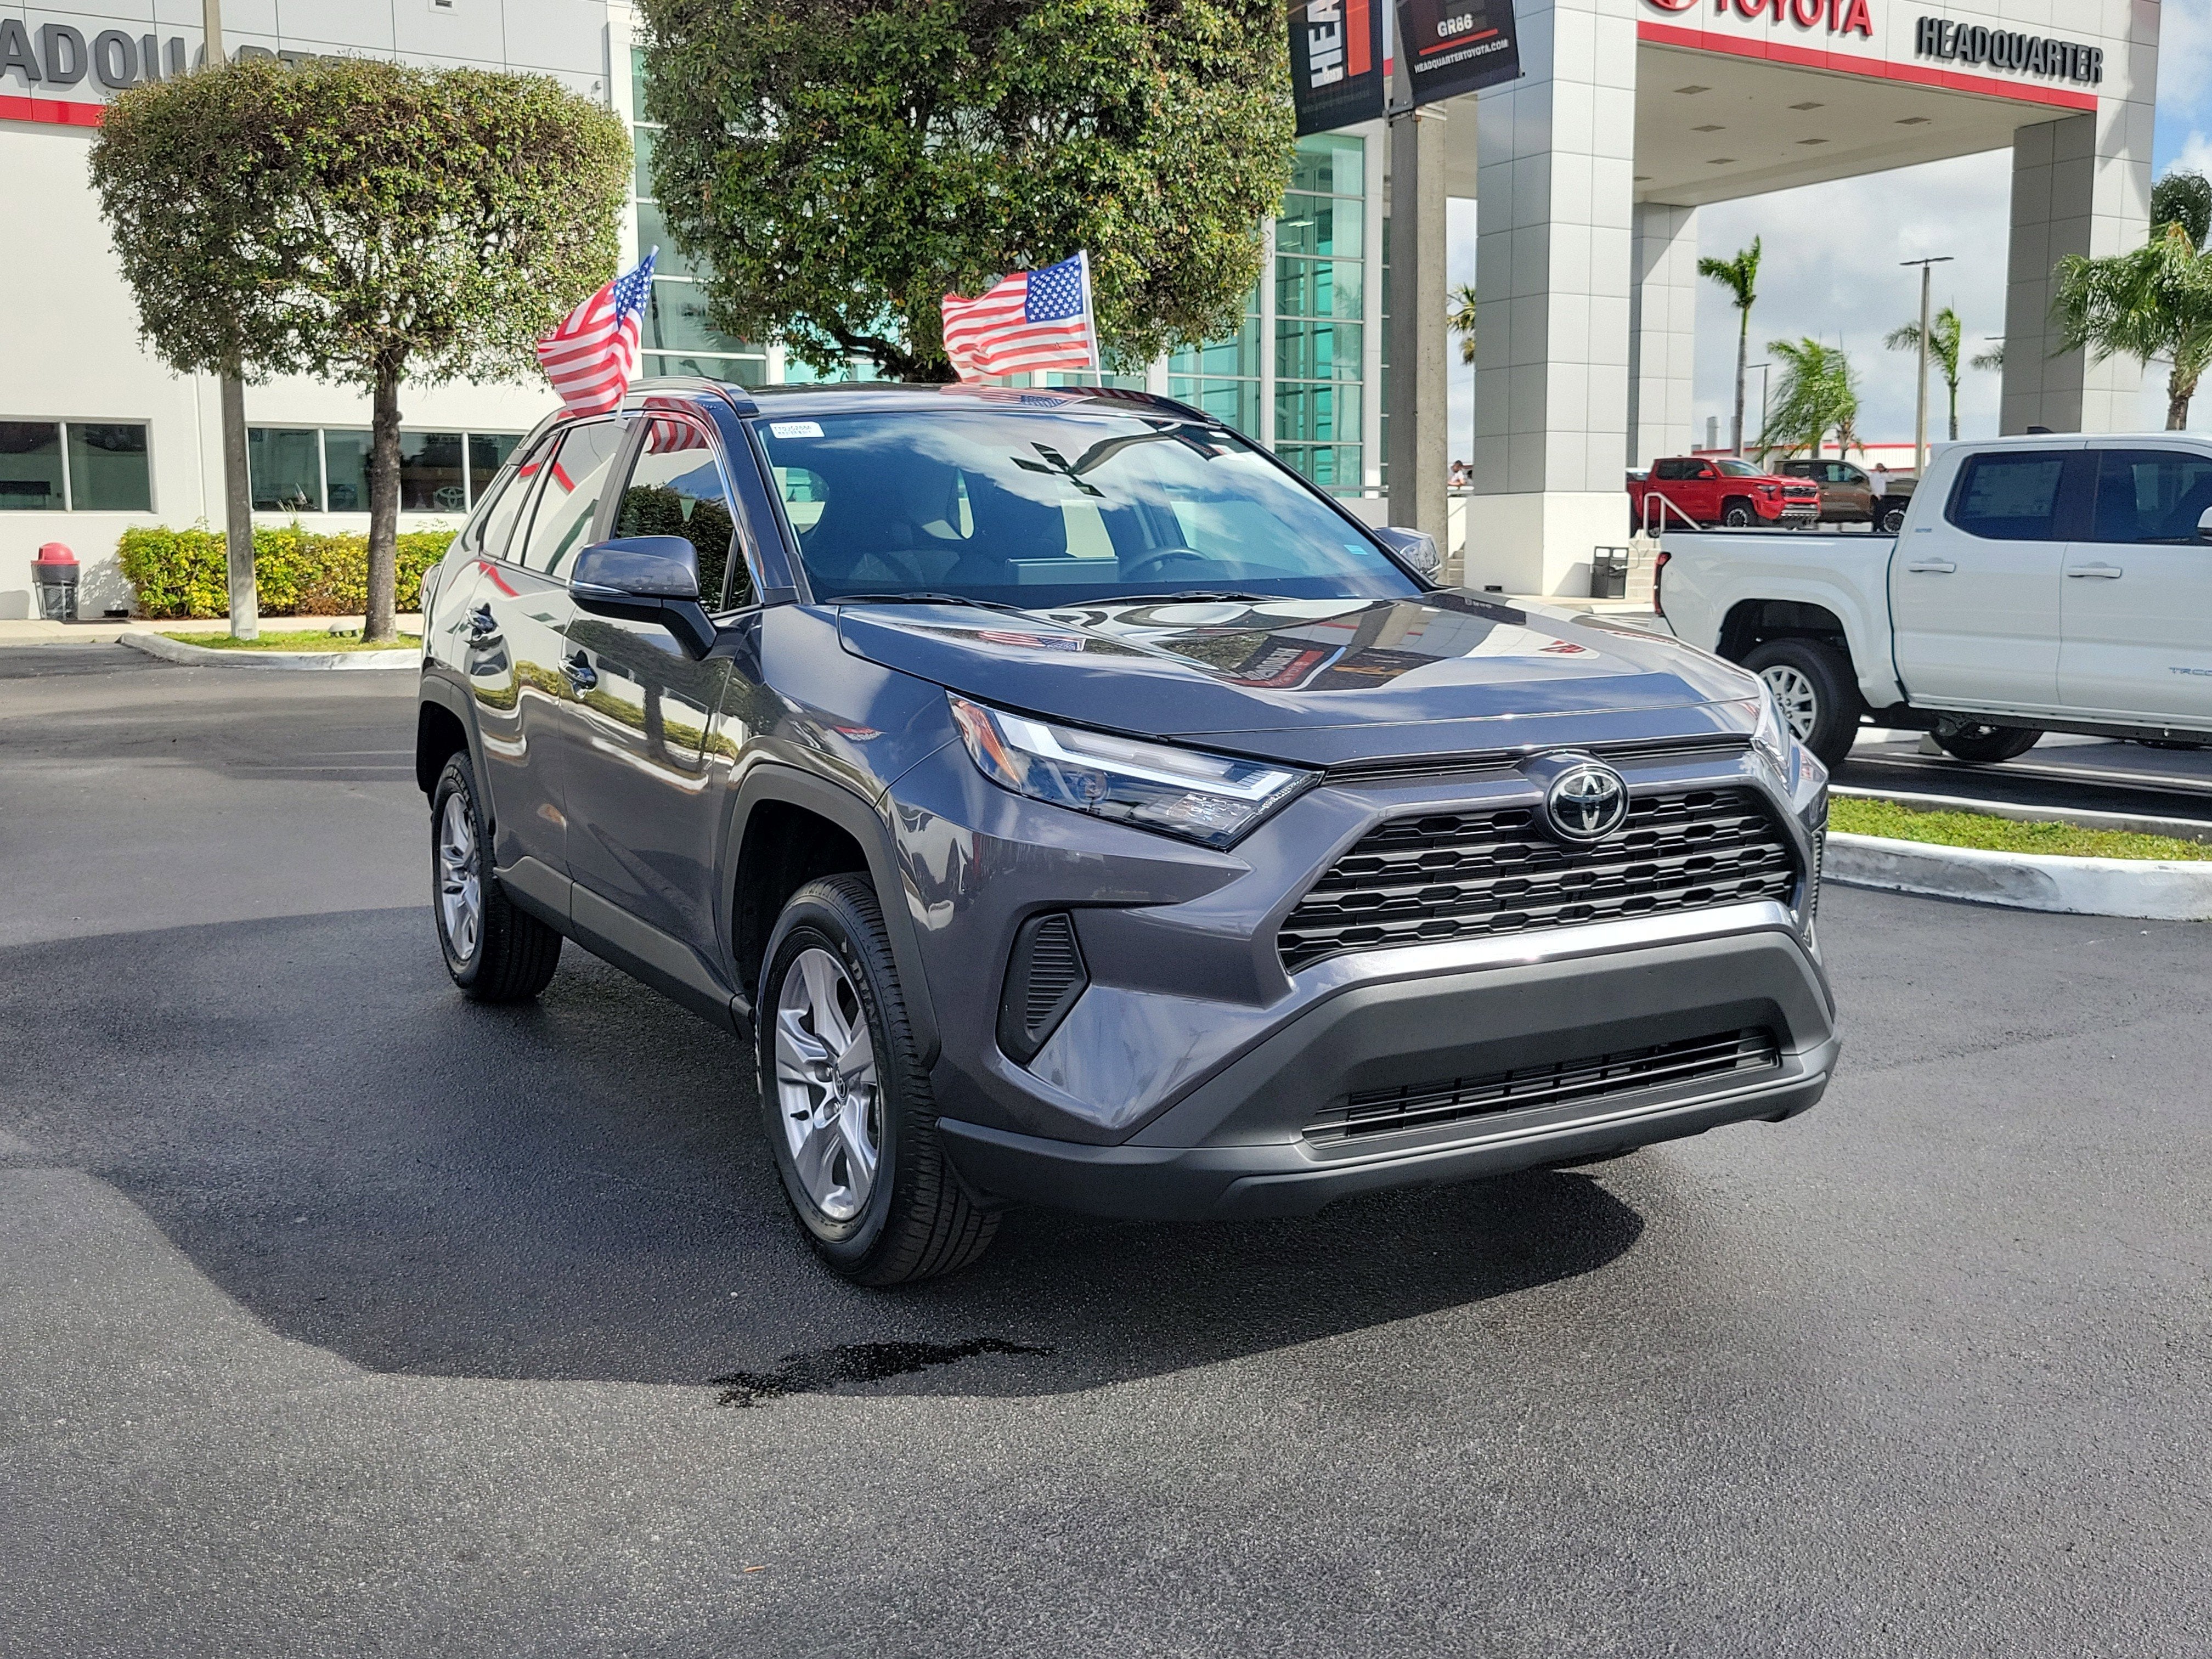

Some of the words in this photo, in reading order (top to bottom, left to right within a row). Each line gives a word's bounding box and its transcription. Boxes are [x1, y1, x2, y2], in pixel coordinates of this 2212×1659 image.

[1437, 14, 1474, 37] GR86
[1720, 0, 1874, 35] OTA
[1414, 38, 1509, 74] HEADQUARTERTOYOTA.COM
[1916, 16, 2103, 83] HEADQUARTER
